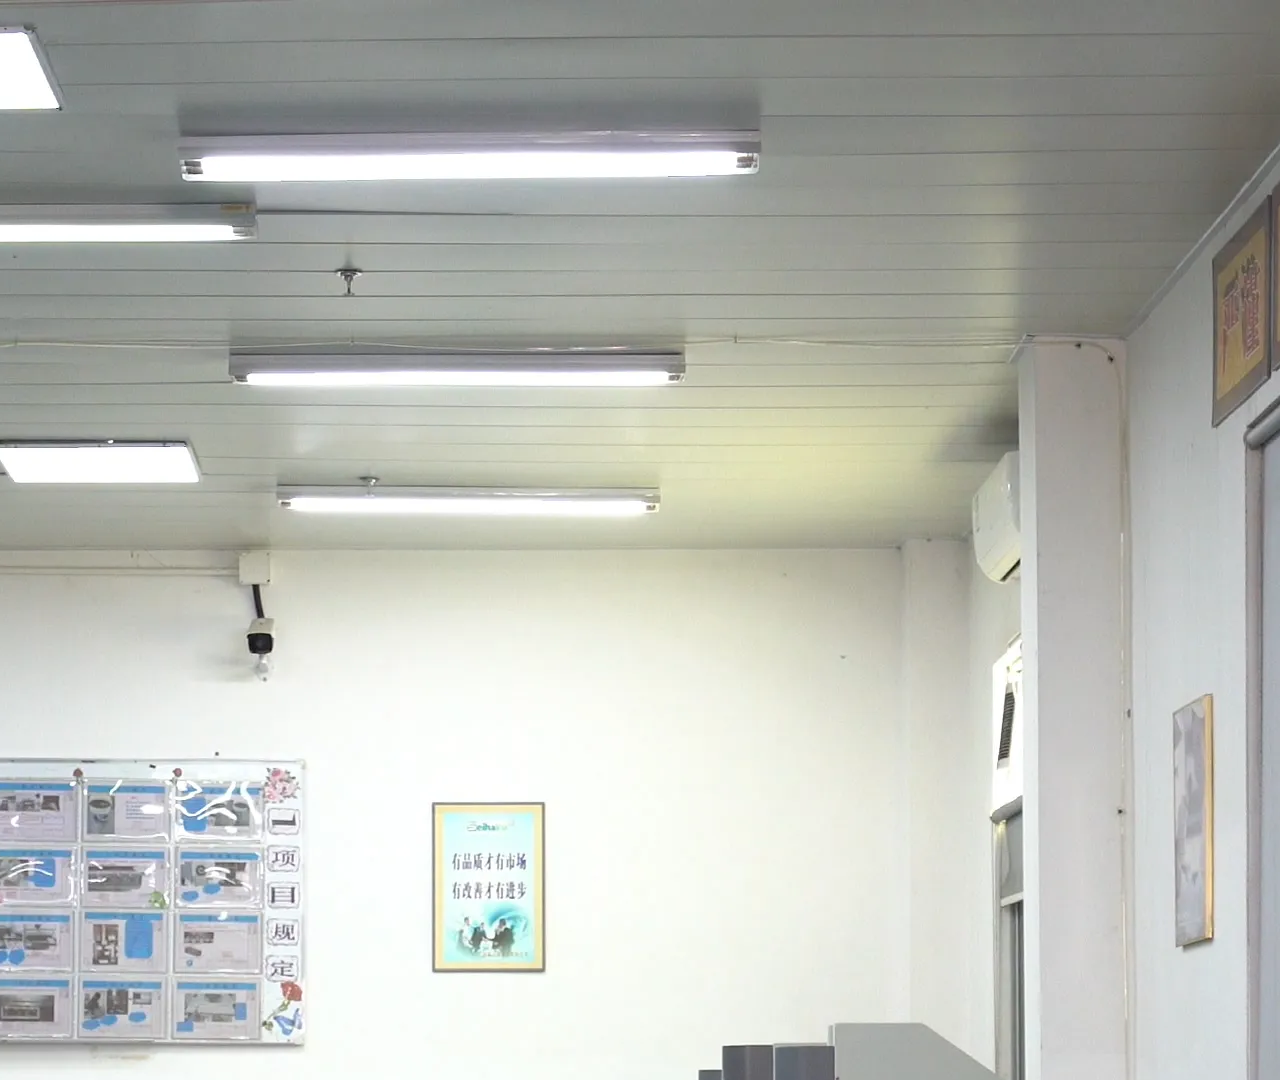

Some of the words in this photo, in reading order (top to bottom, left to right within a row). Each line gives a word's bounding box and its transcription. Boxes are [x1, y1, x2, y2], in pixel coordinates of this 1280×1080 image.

[452, 852, 527, 871] 有品质才有市场
[452, 881, 527, 900] 有改善才有进步
